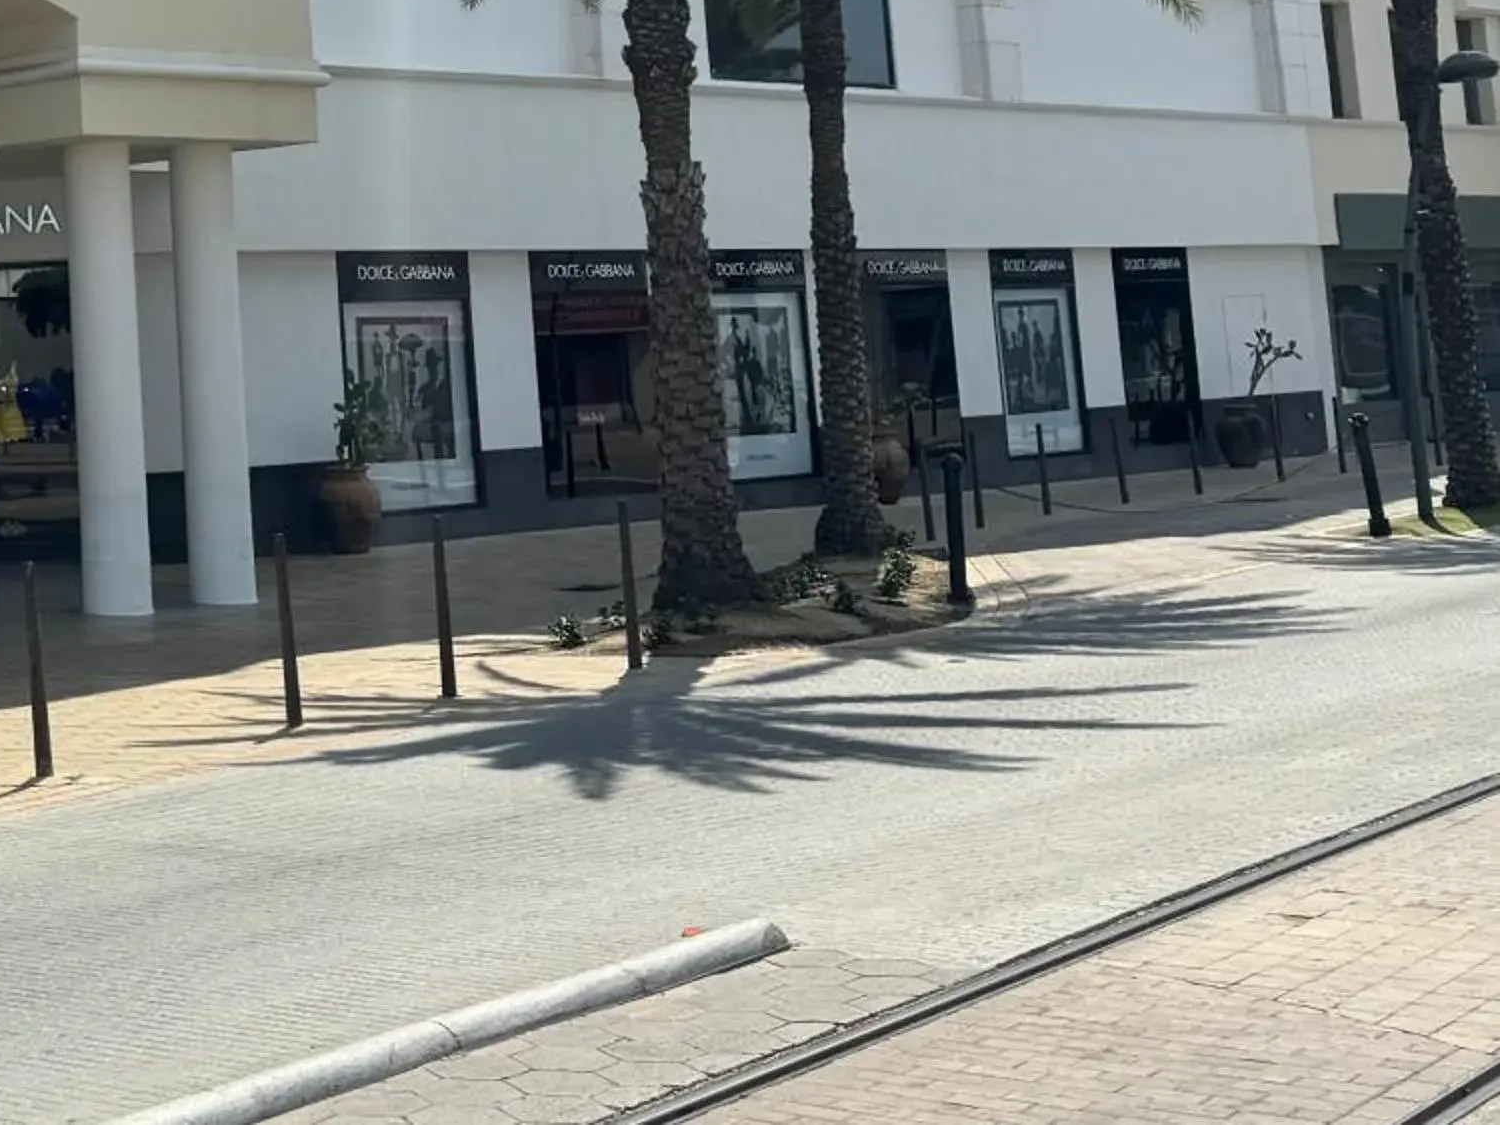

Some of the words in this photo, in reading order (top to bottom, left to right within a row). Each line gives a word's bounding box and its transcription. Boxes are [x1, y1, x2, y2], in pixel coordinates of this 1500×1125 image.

[357, 264, 396, 280] DOLCE
[400, 264, 455, 280] GABBANA
[547, 263, 580, 279] DOLCE
[585, 262, 635, 278] GABBANA
